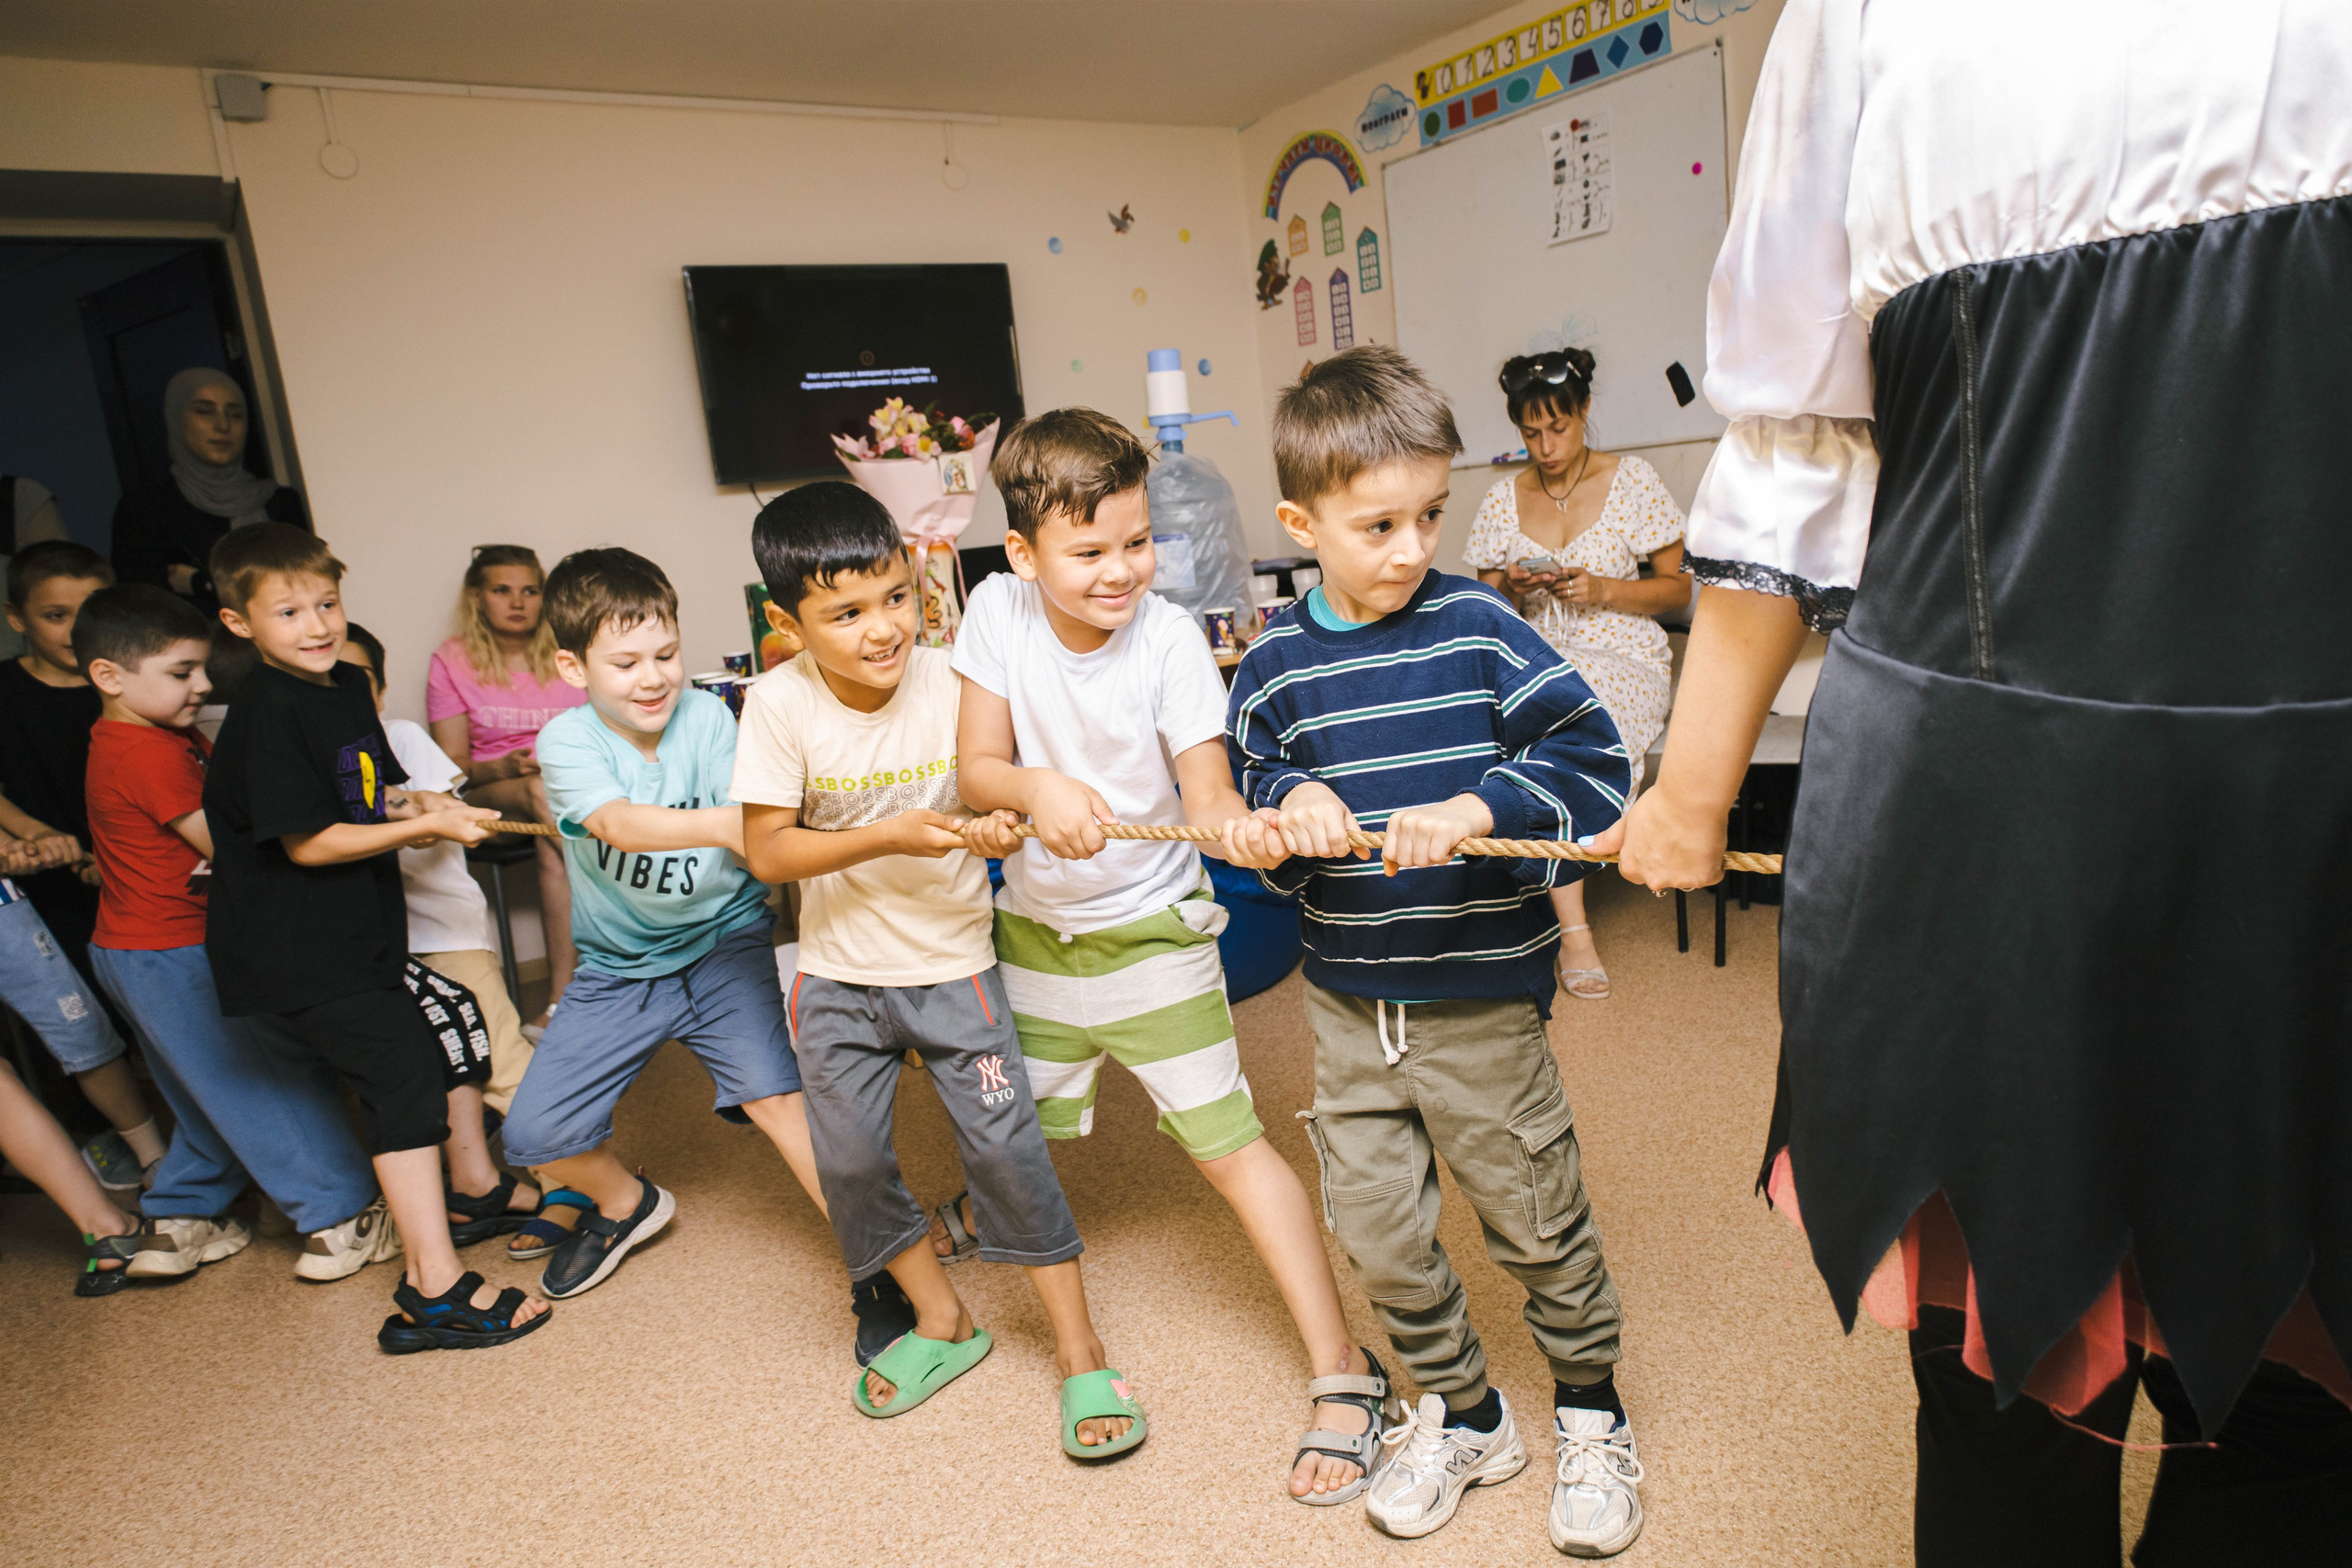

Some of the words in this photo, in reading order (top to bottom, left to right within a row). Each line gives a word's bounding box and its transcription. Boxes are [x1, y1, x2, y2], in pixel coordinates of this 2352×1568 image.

[1442, 62, 1453, 94] 0
[1464, 52, 1474, 85] 1
[1481, 44, 1495, 78] 2
[1502, 35, 1517, 68] 3
[1527, 25, 1540, 57] 4
[1547, 14, 1562, 50] 5
[1572, 5, 1588, 39] 6
[1595, 0, 1610, 29] 7
[480, 705, 564, 729] THIN
[596, 839, 698, 896] VIBES
[981, 1087, 1014, 1106] WYO
